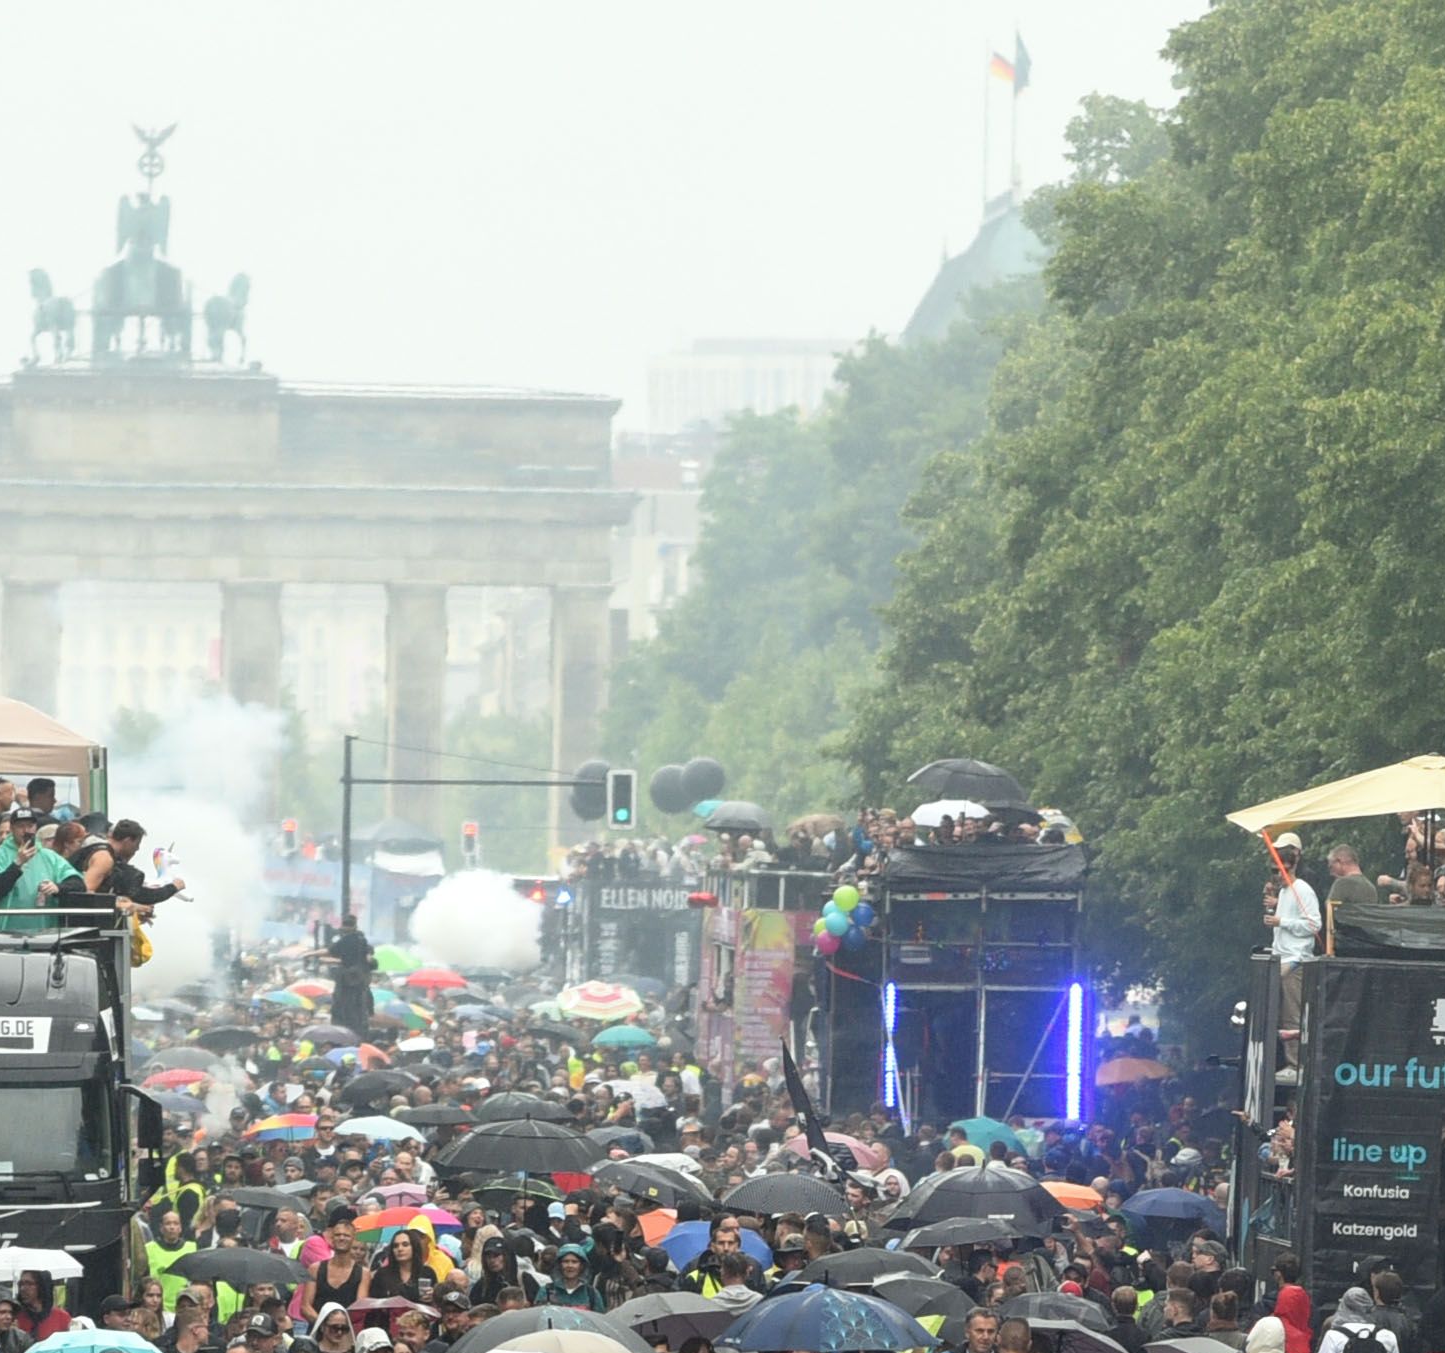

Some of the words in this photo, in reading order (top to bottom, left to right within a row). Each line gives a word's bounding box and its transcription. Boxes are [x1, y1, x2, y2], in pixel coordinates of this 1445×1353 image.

[1334, 1061, 1396, 1087] our
[1333, 1137, 1383, 1163] line
[1390, 1145, 1427, 1172] up
[1343, 1184, 1410, 1199] Konfusia
[1332, 1222, 1418, 1240] Katzengold
